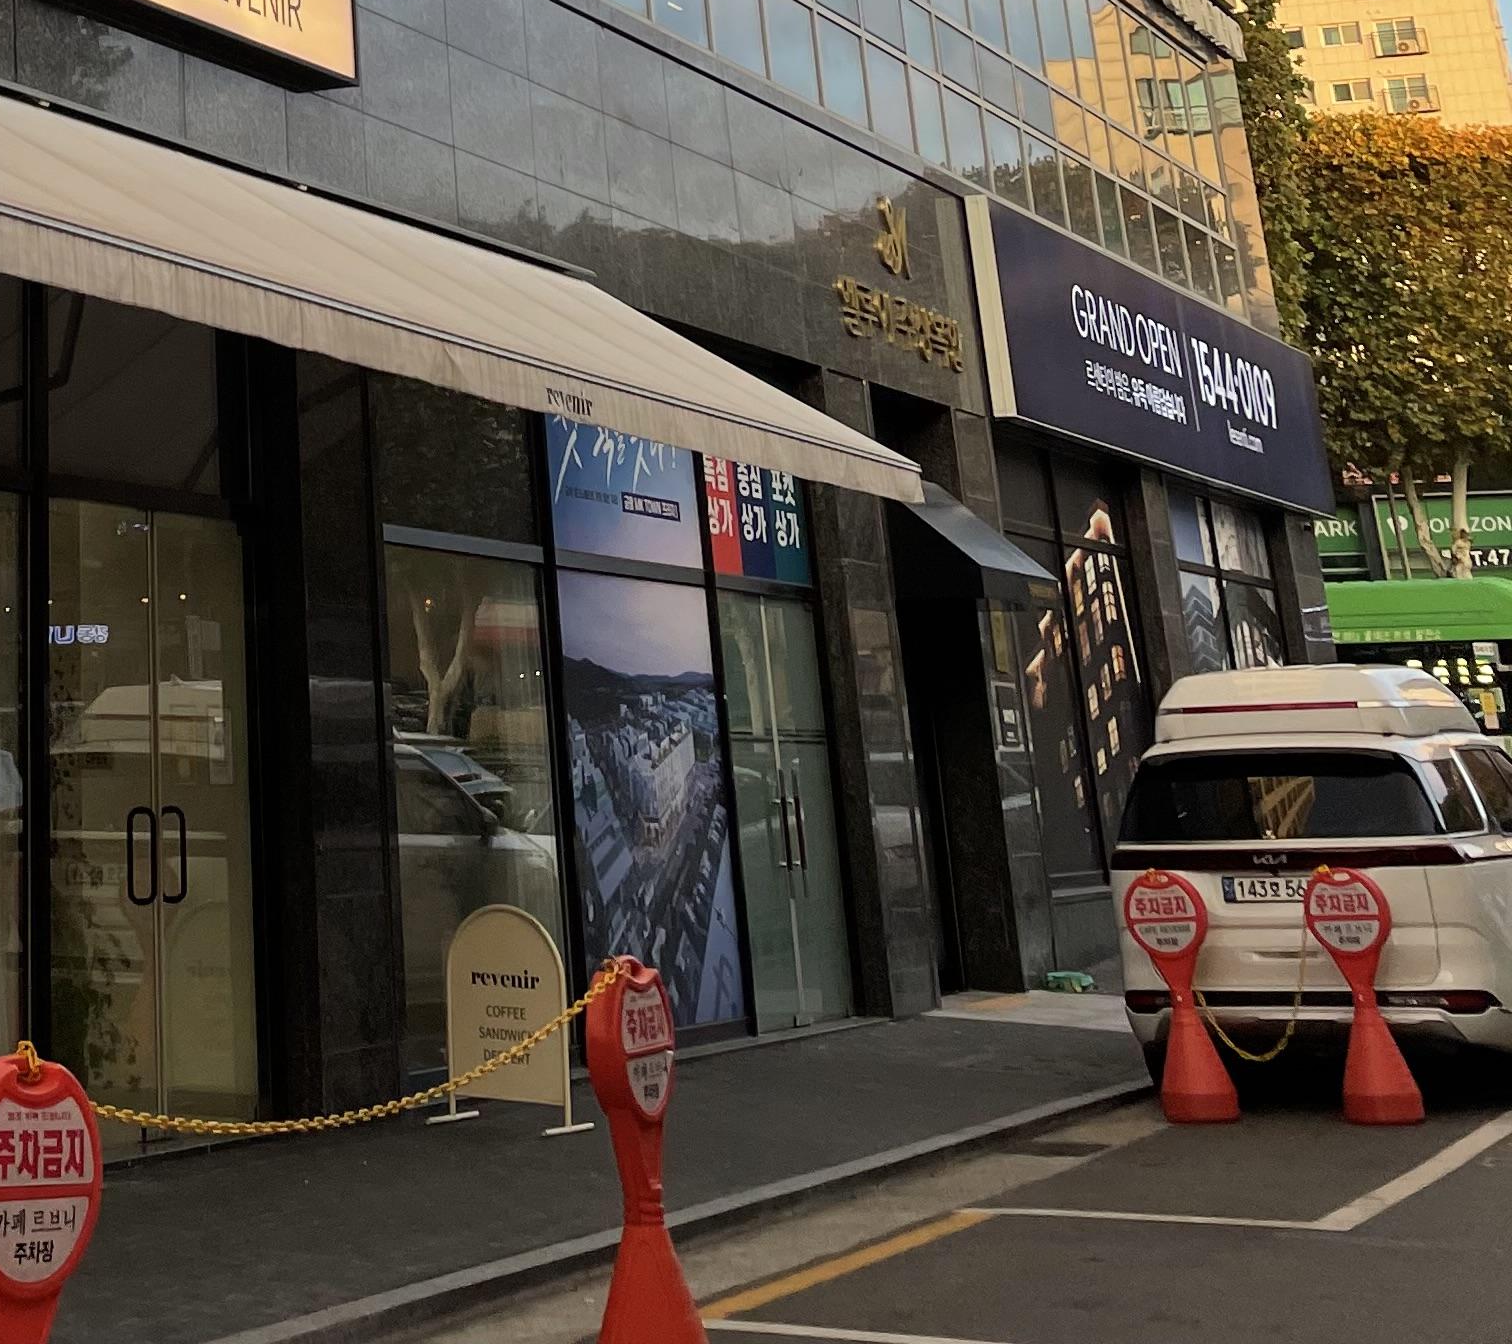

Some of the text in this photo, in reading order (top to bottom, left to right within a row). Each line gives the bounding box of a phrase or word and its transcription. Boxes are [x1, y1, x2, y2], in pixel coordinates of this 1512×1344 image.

[1071, 284, 1183, 379] GRAND OPEN
[545, 387, 593, 417] revenir
[707, 495, 734, 538] 상가
[741, 502, 768, 544] 상가
[775, 509, 801, 549] 상가
[1314, 519, 1358, 538] ARK
[1285, 879, 1308, 898] 56
[471, 969, 540, 990] revenir
[485, 1005, 528, 1021] COFFEE
[483, 1048, 531, 1066] DEERT
[31, 1204, 76, 1233] 르브니
[14, 1239, 55, 1265] 주차장
